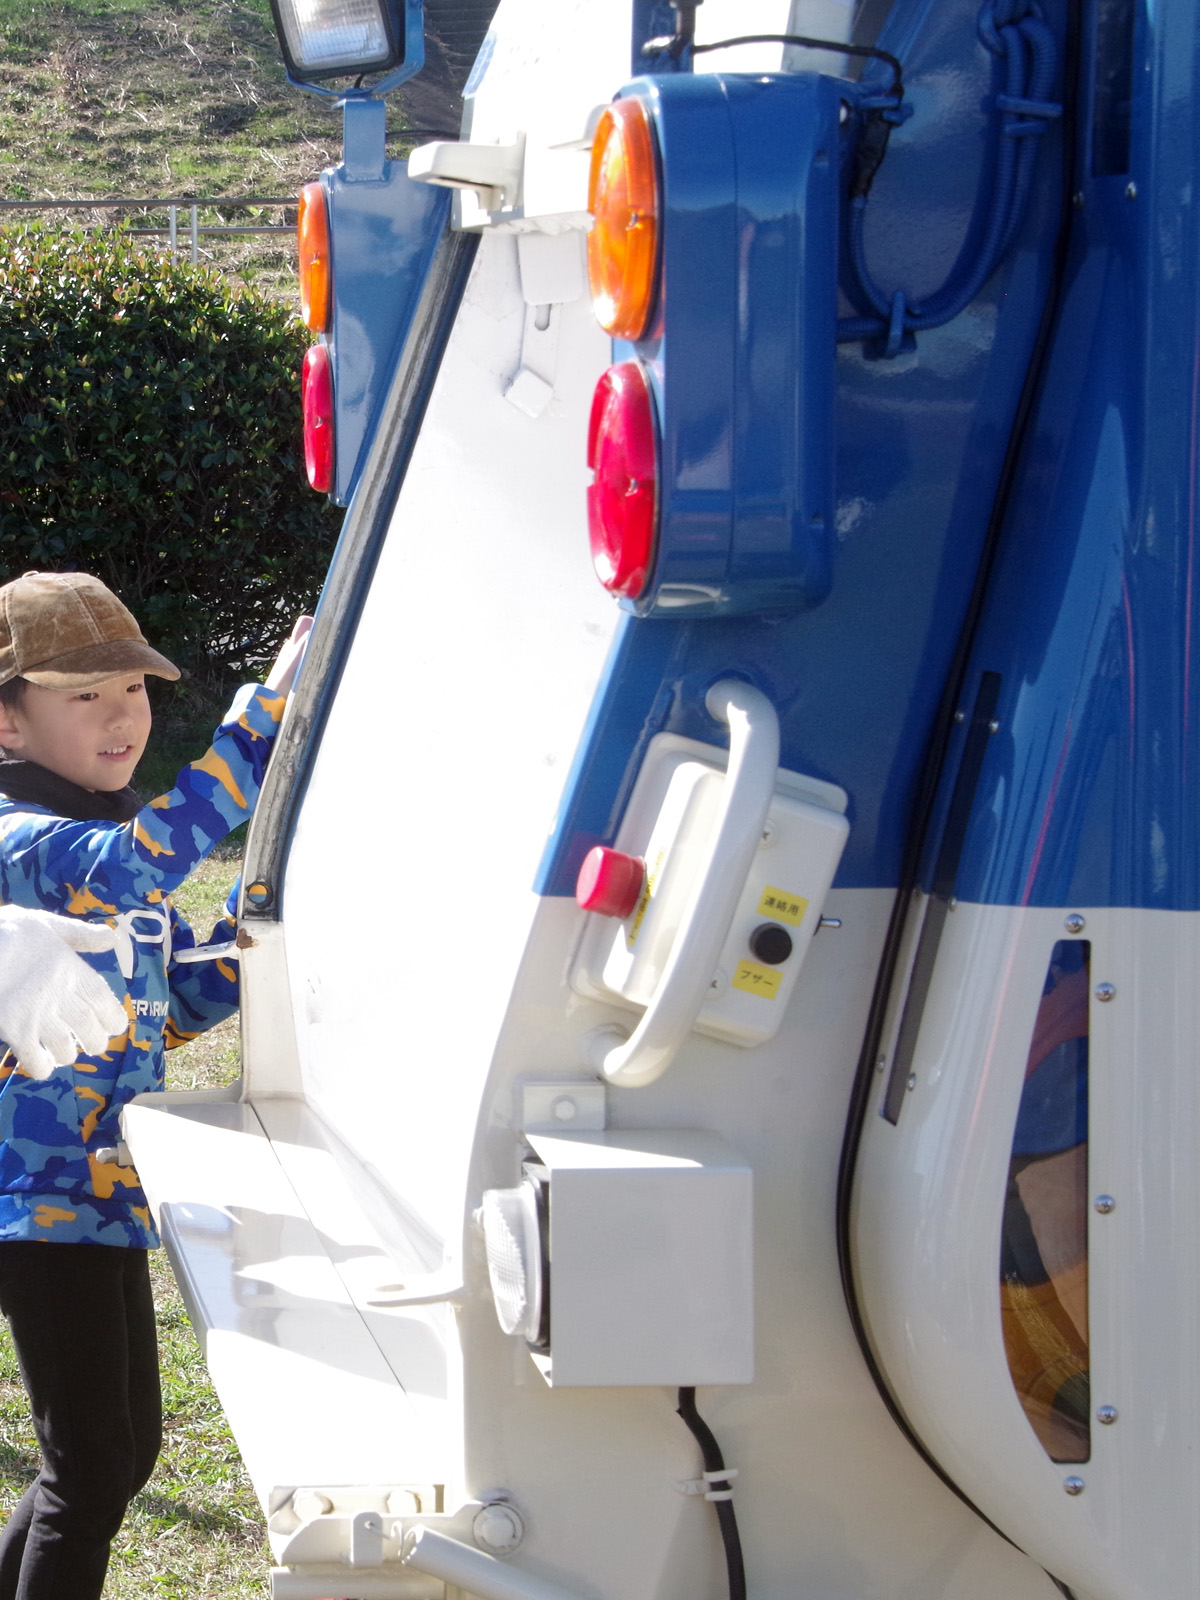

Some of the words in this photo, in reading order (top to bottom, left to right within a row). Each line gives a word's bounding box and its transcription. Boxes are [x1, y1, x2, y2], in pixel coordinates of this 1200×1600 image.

[763, 895, 800, 917] 連絡用
[740, 969, 774, 987] ブザー
